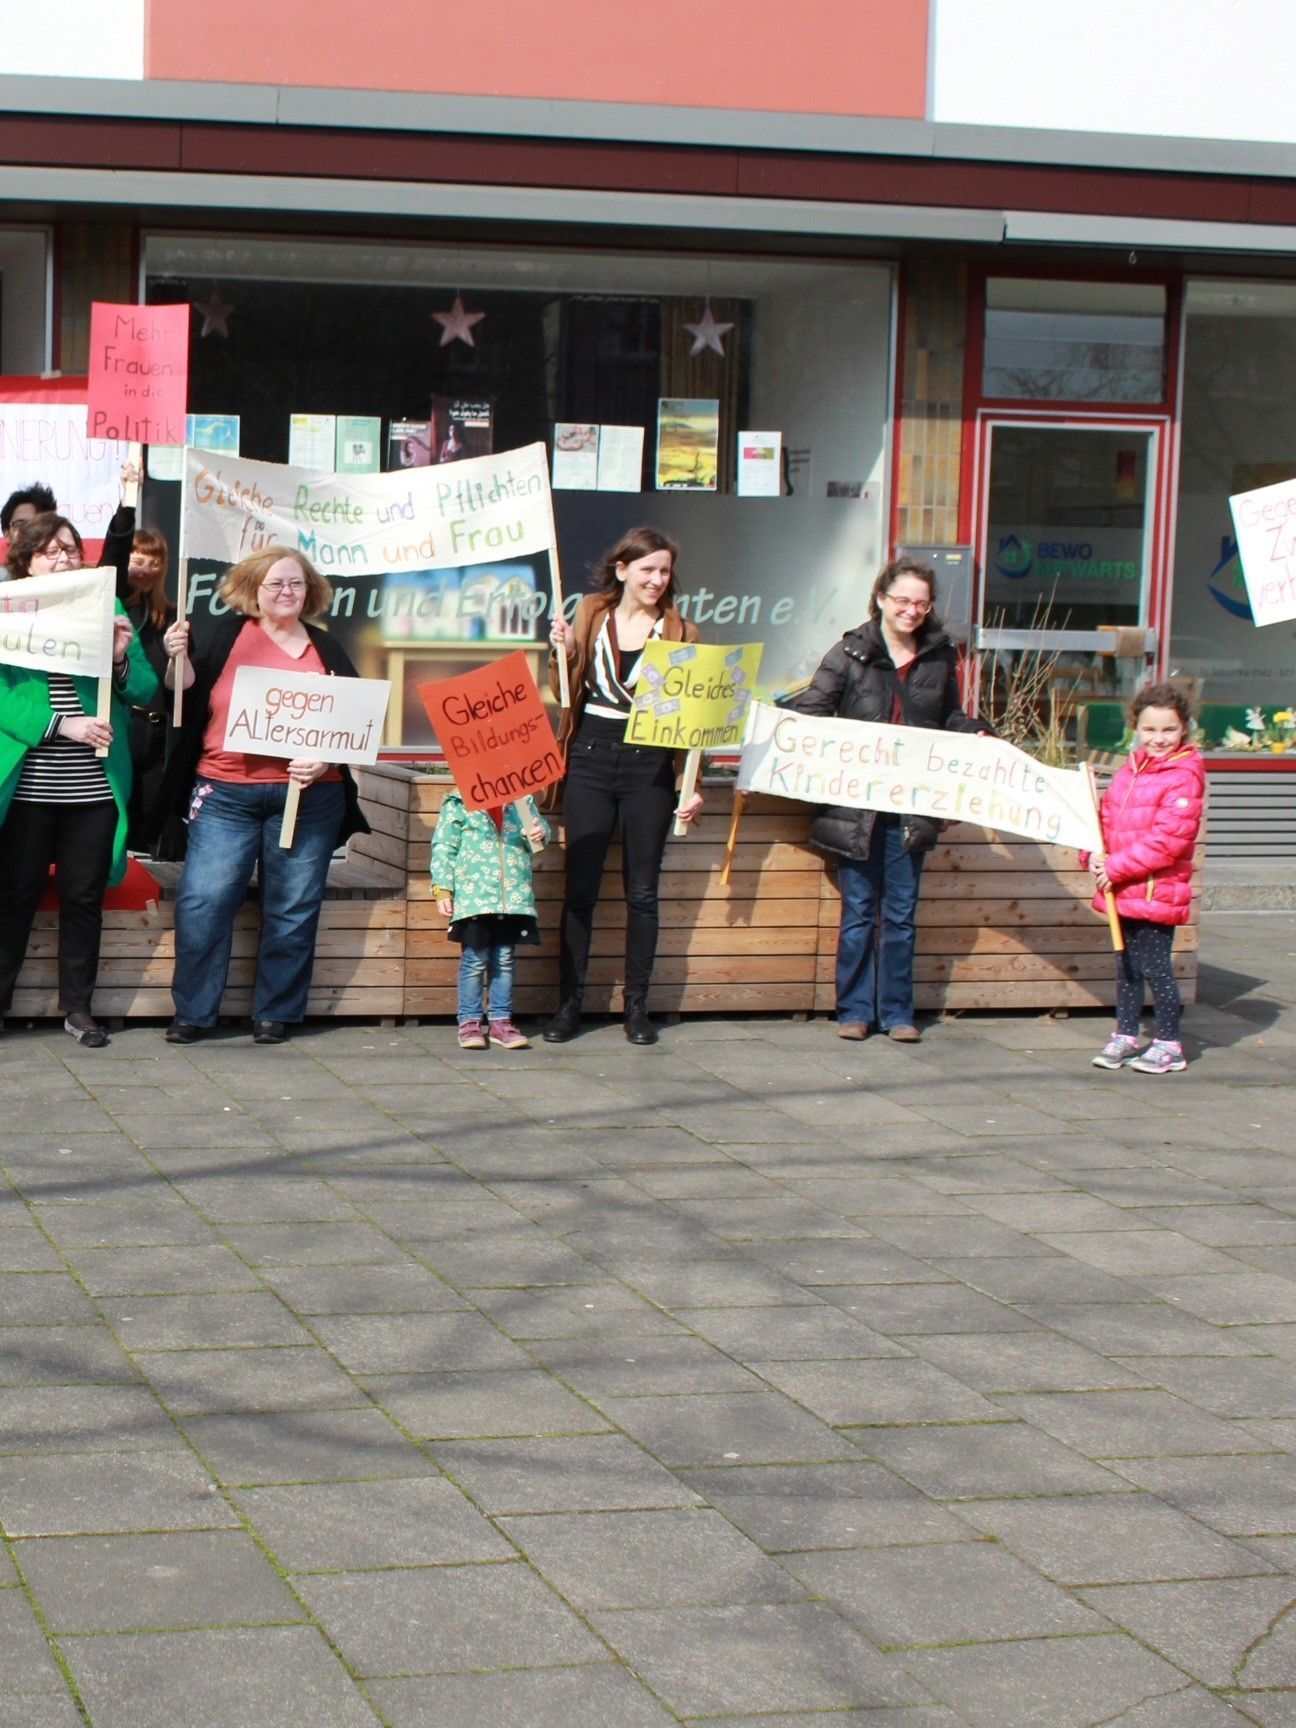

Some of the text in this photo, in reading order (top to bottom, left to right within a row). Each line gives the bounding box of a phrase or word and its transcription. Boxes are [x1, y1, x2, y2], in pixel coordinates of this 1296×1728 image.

[115, 314, 170, 341] Mehr
[104, 345, 173, 376] Frauen
[124, 384, 164, 398] in die
[93, 411, 177, 443] Politik
[294, 484, 365, 524] Rechte
[376, 491, 415, 524] und
[435, 470, 542, 517] Pflichten
[239, 515, 525, 565] für Mann und Frau
[456, 577, 584, 621] Erfolg
[673, 587, 762, 625] nten
[770, 585, 837, 626] e.V.
[265, 687, 334, 720] gegen
[442, 681, 527, 725] Gleiche
[663, 665, 736, 700] Gleiches
[451, 713, 544, 758] Bildungs-
[631, 709, 738, 748] Einkommen
[470, 751, 561, 803] chancen
[774, 717, 1045, 793] Gerecht bezahlte
[769, 757, 1061, 840] Kindererziehung
